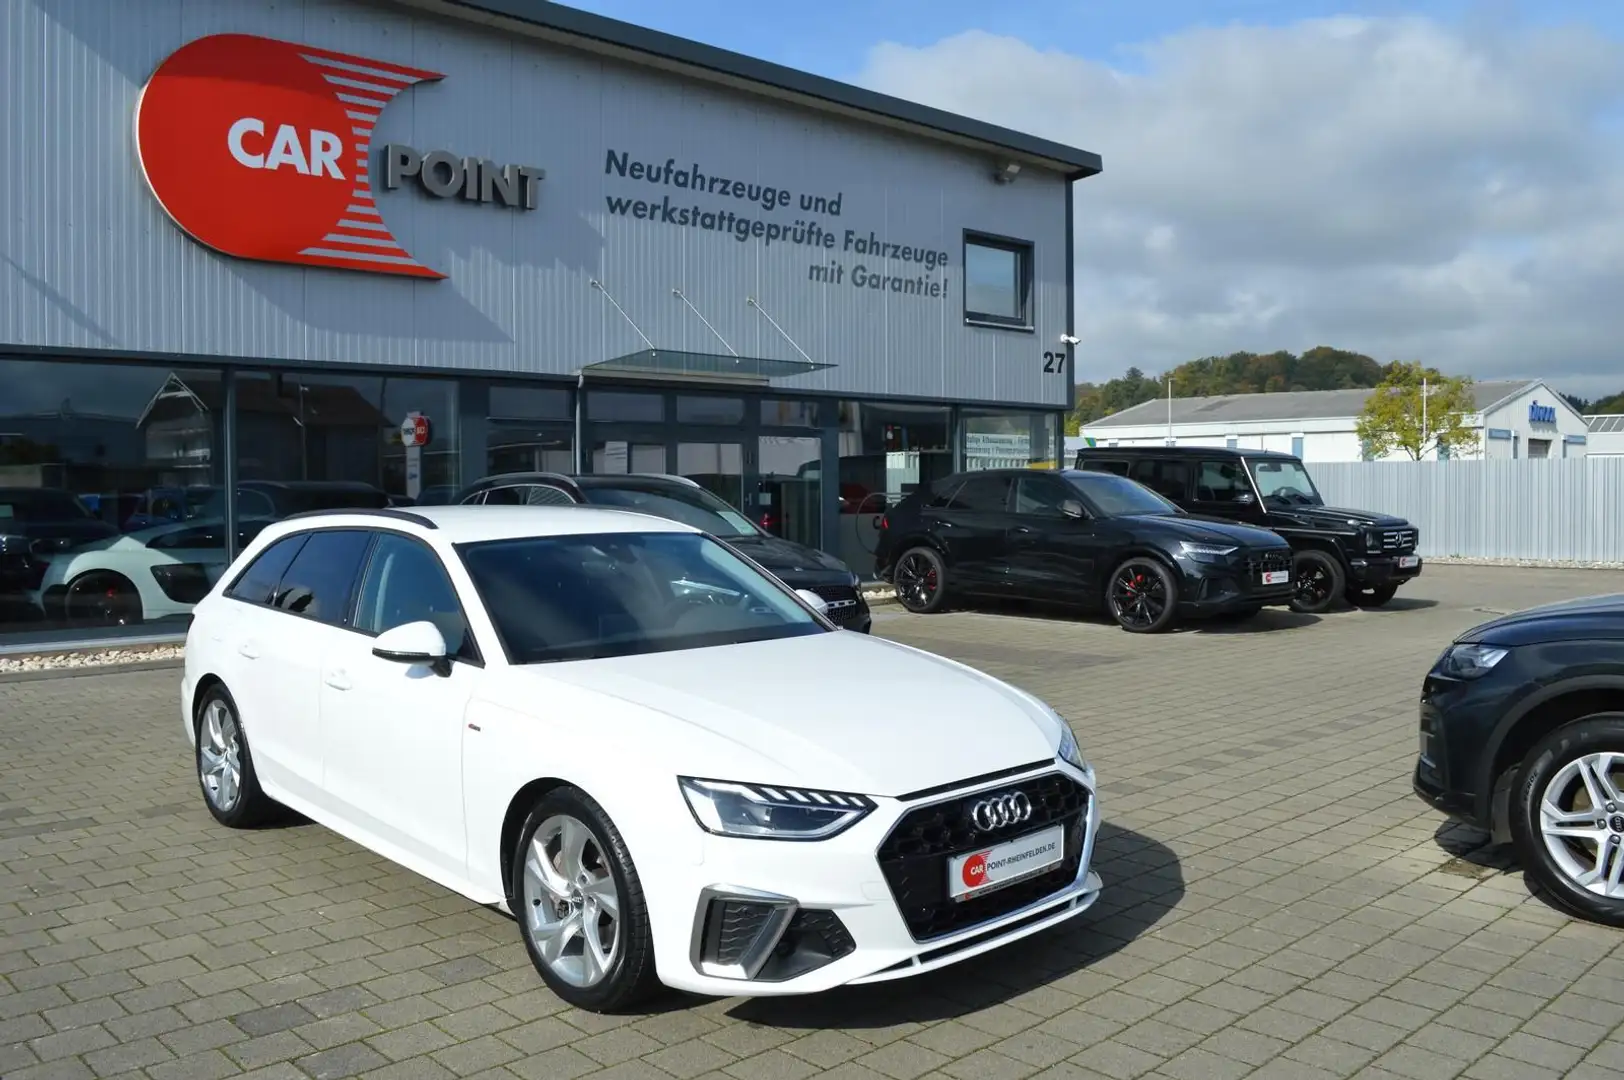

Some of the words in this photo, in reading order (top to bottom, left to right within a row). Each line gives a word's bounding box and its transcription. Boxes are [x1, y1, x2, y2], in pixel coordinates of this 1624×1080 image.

[227, 117, 346, 180] CAR
[384, 143, 546, 210] POINT
[605, 149, 791, 211] Neufahrzeuge
[800, 192, 843, 216] und
[606, 195, 836, 249] werkstattgeprüfte
[843, 229, 948, 271] Fahrzeuge
[808, 260, 844, 284] mit
[851, 264, 948, 298] Garantie!
[1043, 351, 1066, 374] 27
[970, 864, 984, 876] CAR
[986, 842, 1056, 872] POINT-RHEINFELDEN.DE
